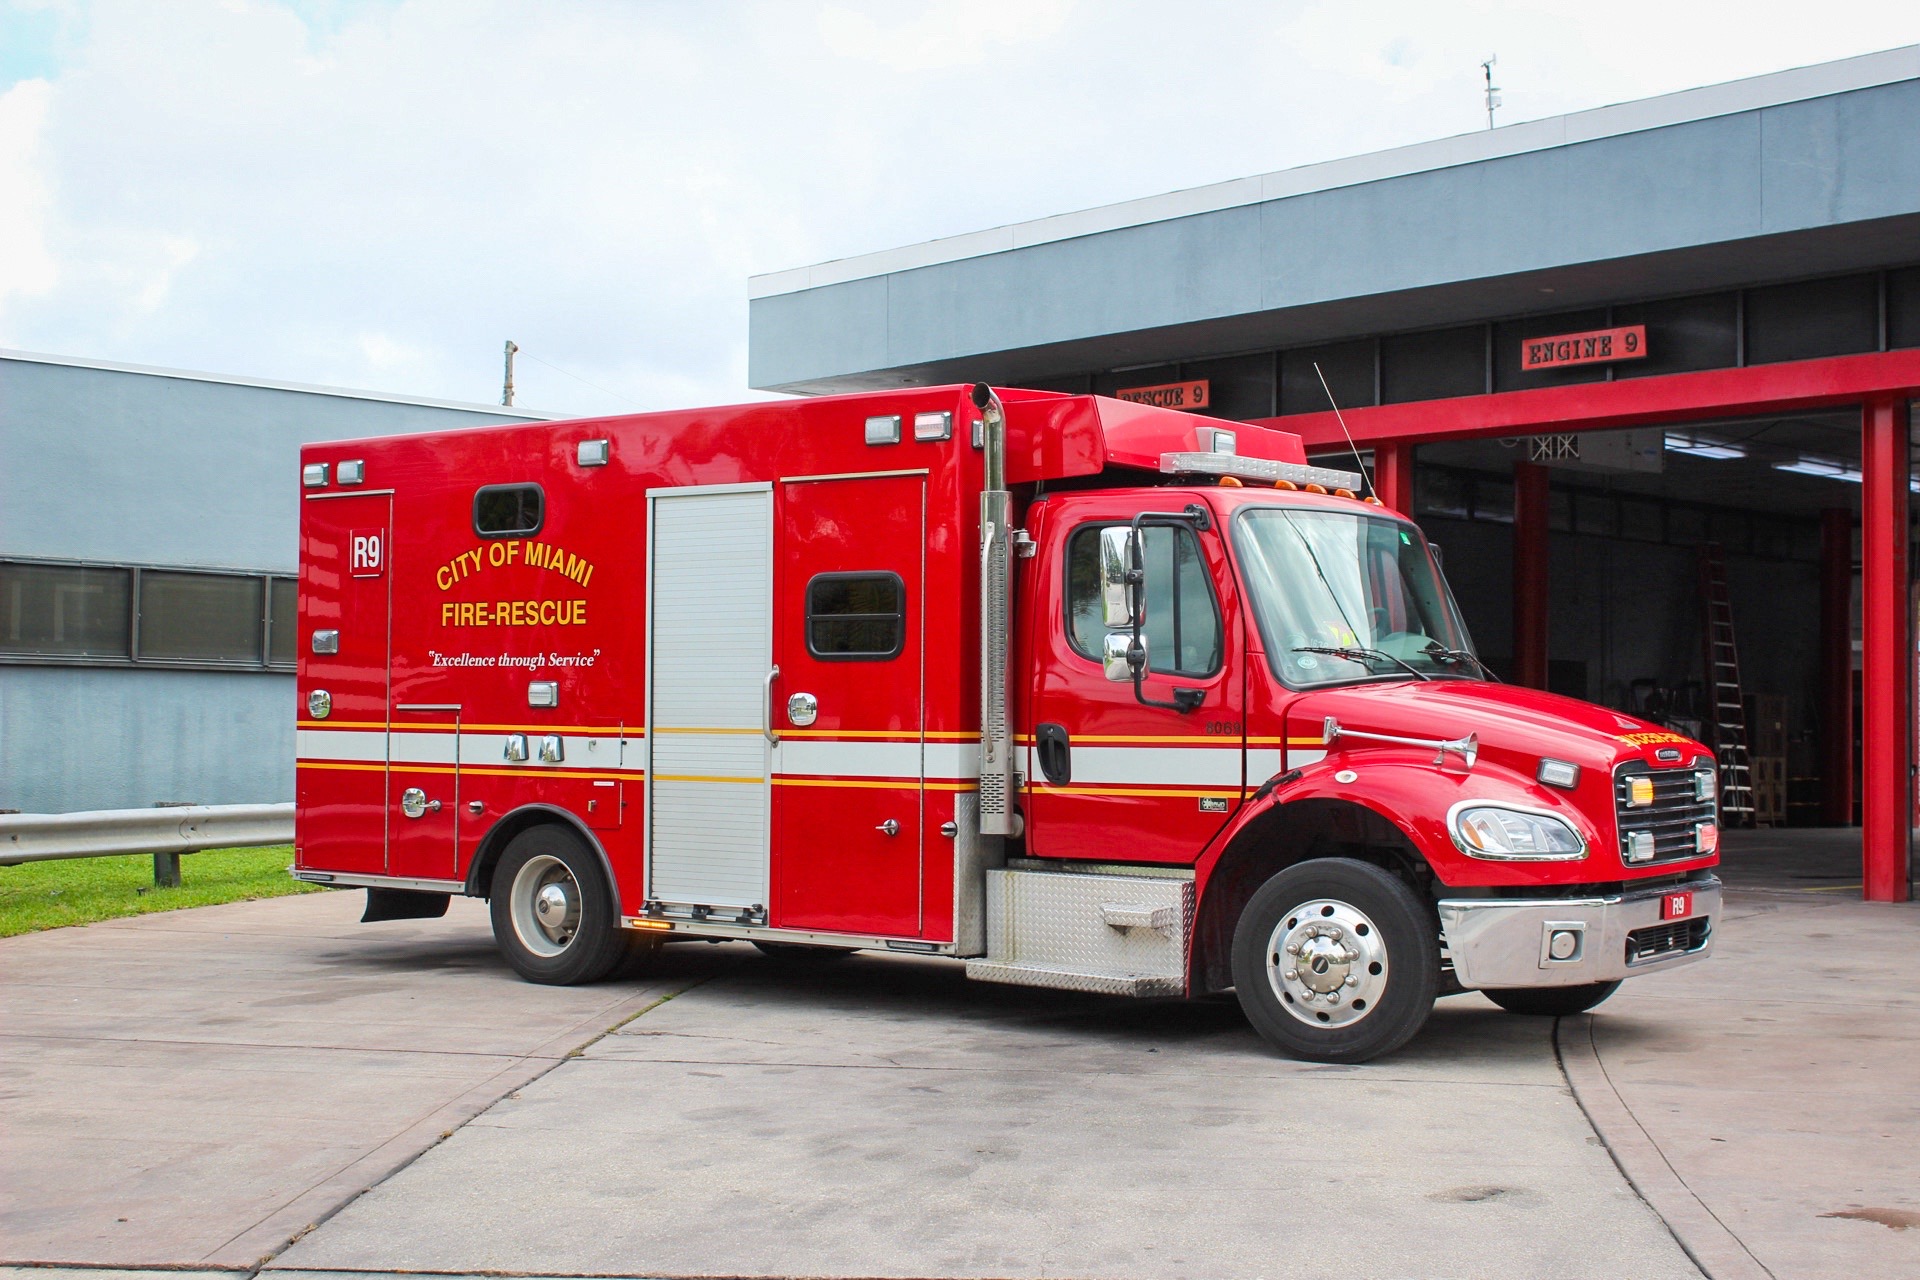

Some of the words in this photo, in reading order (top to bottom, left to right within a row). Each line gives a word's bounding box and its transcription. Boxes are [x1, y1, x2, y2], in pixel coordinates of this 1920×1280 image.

[1528, 335, 1612, 365] ENGINE
[1624, 332, 1638, 353] 9
[1193, 385, 1203, 403] 9
[354, 535, 380, 568] R9
[436, 547, 483, 591] CITY
[489, 541, 520, 567] OF
[524, 541, 594, 588] MIAMI
[442, 600, 586, 626] FIRE-RESCUE
[498, 652, 545, 671] through
[1672, 896, 1685, 916] R9
